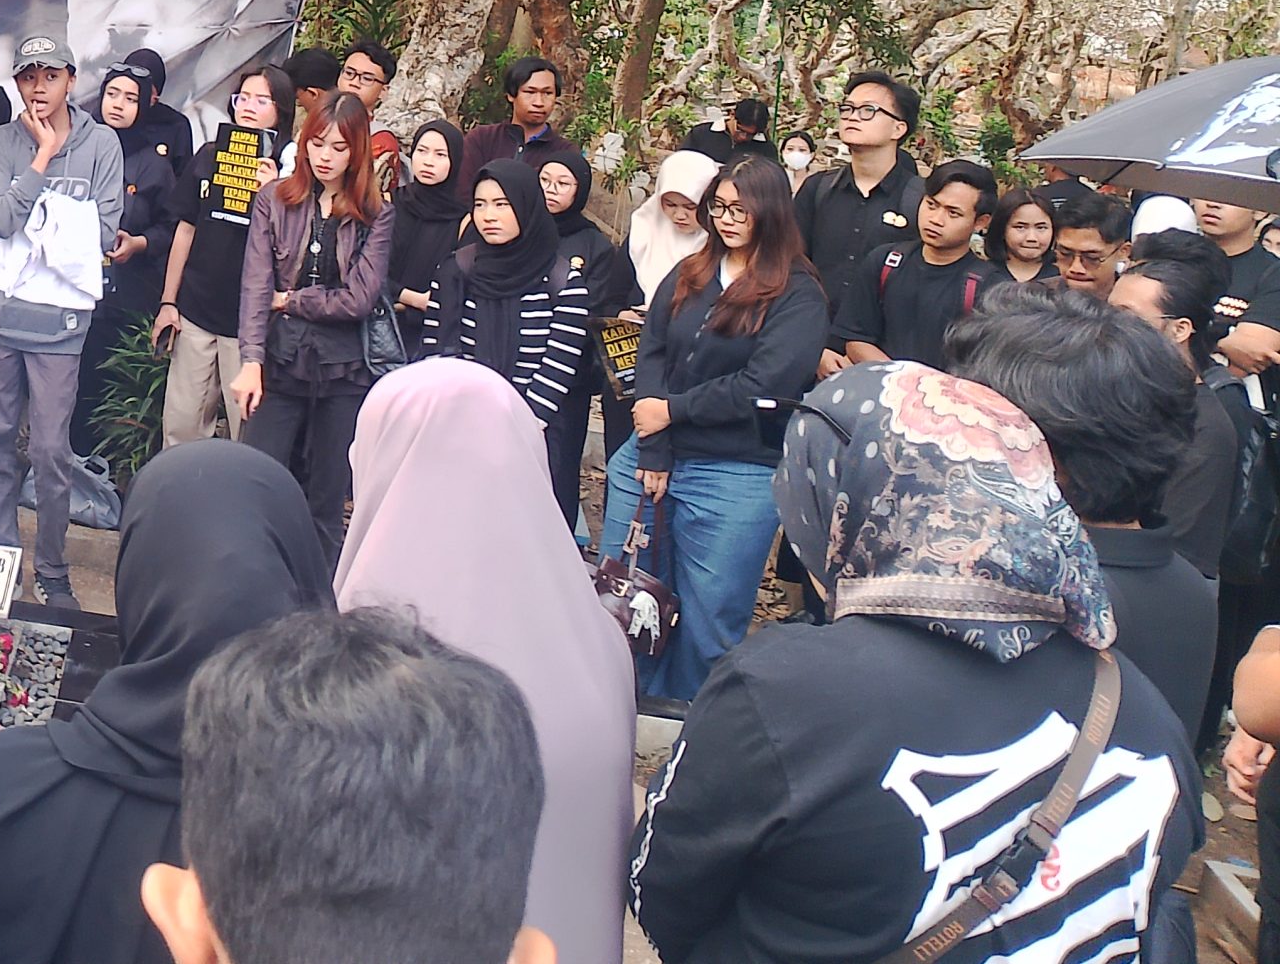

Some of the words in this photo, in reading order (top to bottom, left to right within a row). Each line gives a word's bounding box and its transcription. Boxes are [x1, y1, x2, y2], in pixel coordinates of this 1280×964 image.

[231, 131, 259, 145] SAMPAI
[219, 163, 256, 179] MELAKUKA
[213, 174, 259, 192] KRIMINALISA
[223, 187, 251, 202] KEPADA
[223, 198, 248, 213] WARGA
[1086, 694, 1112, 745] ROTELLI
[1048, 782, 1076, 823] TELLI
[913, 921, 965, 962] ROTELLI
